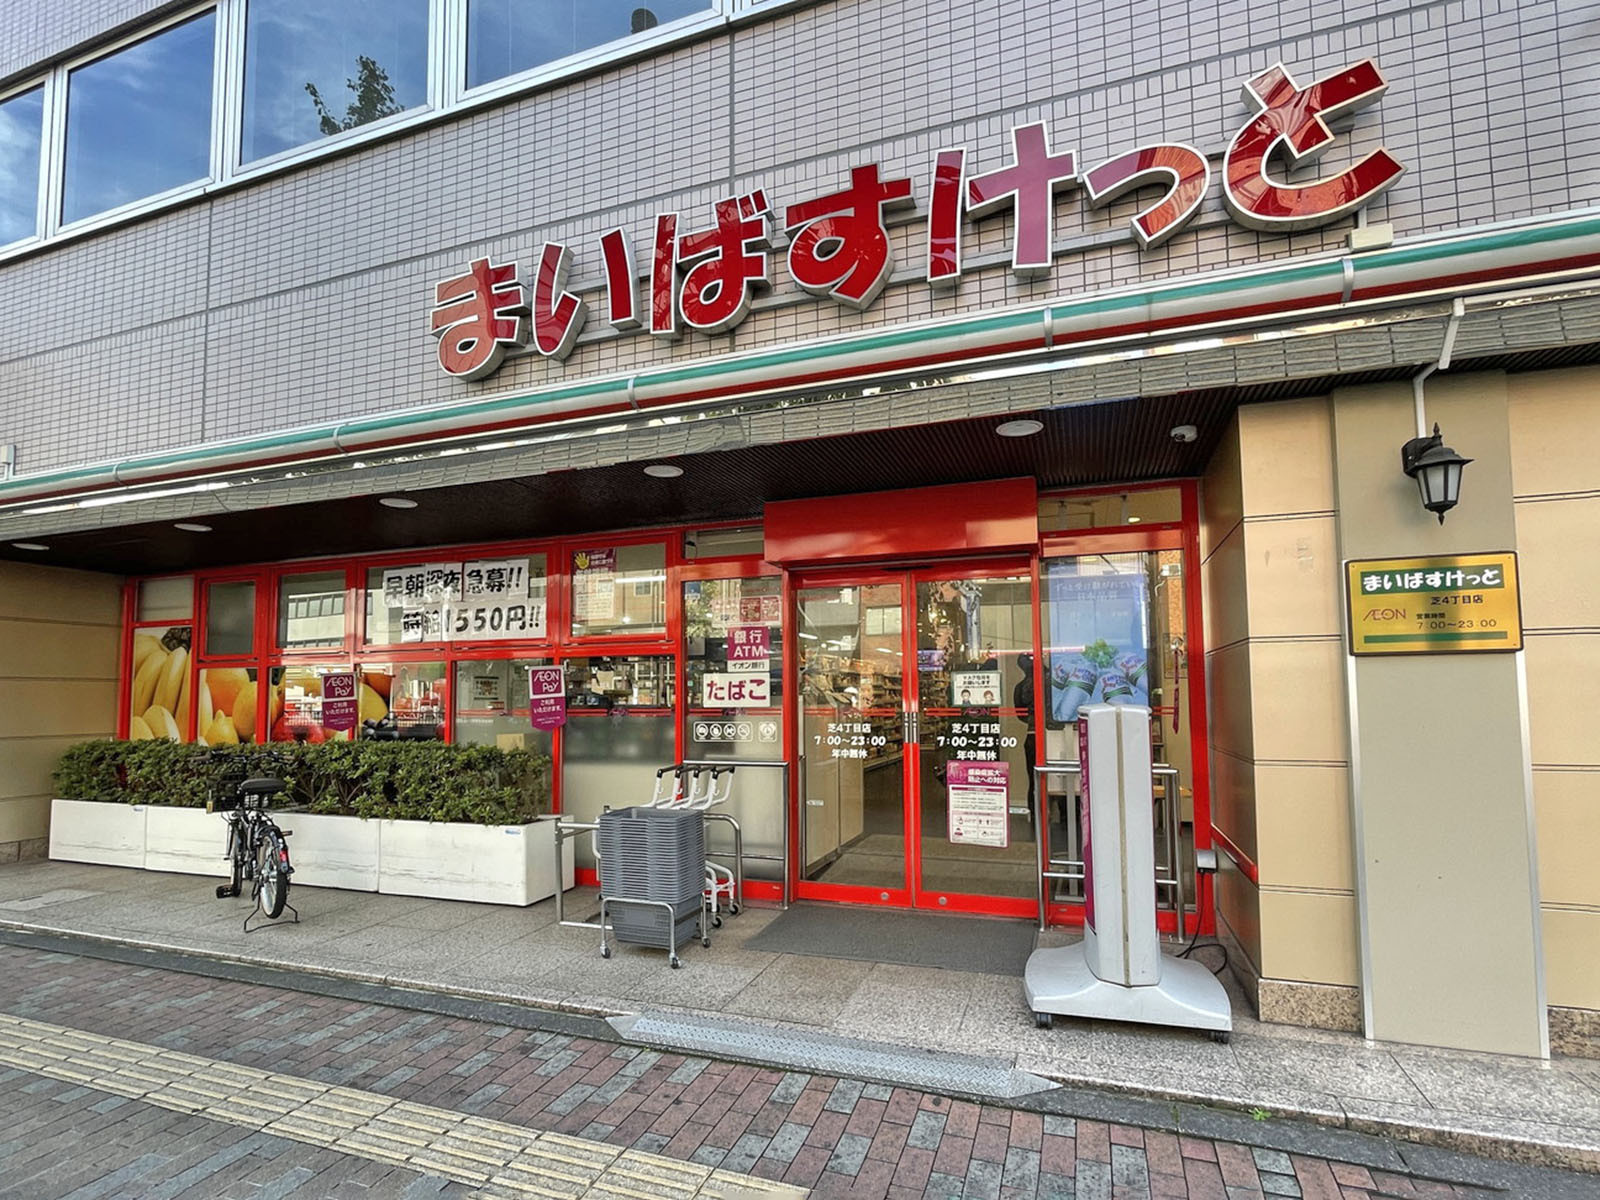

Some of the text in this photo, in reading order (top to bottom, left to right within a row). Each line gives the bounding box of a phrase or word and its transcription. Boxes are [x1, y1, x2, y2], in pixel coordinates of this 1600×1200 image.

[428, 58, 1406, 381] まいばすけっと
[1363, 568, 1501, 592] まいばすけっと
[734, 629, 763, 644] 銀行
[733, 645, 764, 658] ATM
[706, 678, 767, 701] たばこ
[827, 723, 872, 734] 芝4丁目店
[951, 723, 1001, 735] 芝4丁目店
[832, 749, 868, 760] 年中無休
[956, 750, 998, 761] 年中無休
